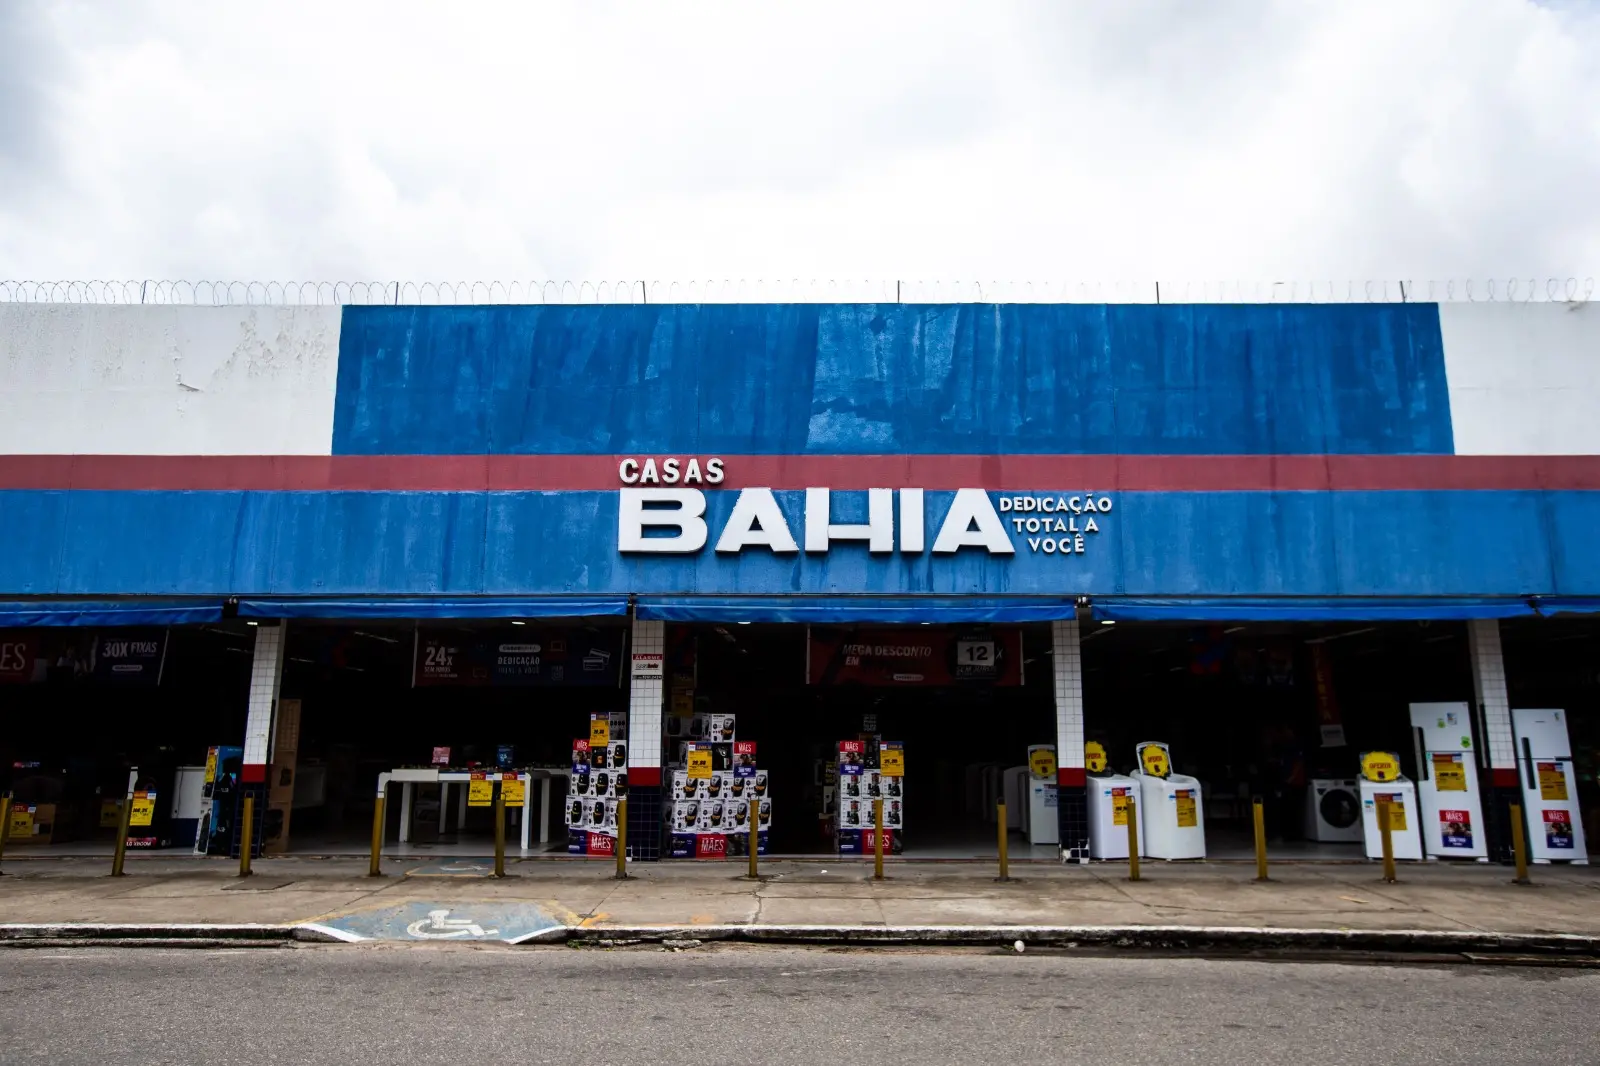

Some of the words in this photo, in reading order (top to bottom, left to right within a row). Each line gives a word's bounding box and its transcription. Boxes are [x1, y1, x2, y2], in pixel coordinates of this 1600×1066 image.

[619, 458, 725, 485] CASAS
[999, 493, 1112, 515] DEDICAÇÃO
[618, 487, 1015, 553] BAHIA
[1012, 517, 1079, 533] TOTAL
[1084, 517, 1099, 532] A
[1028, 533, 1085, 553] VOCÊ
[842, 644, 872, 657] MEGA
[874, 645, 933, 658] DESCONTO
[966, 646, 988, 661] 12
[701, 838, 724, 852] MÃES
